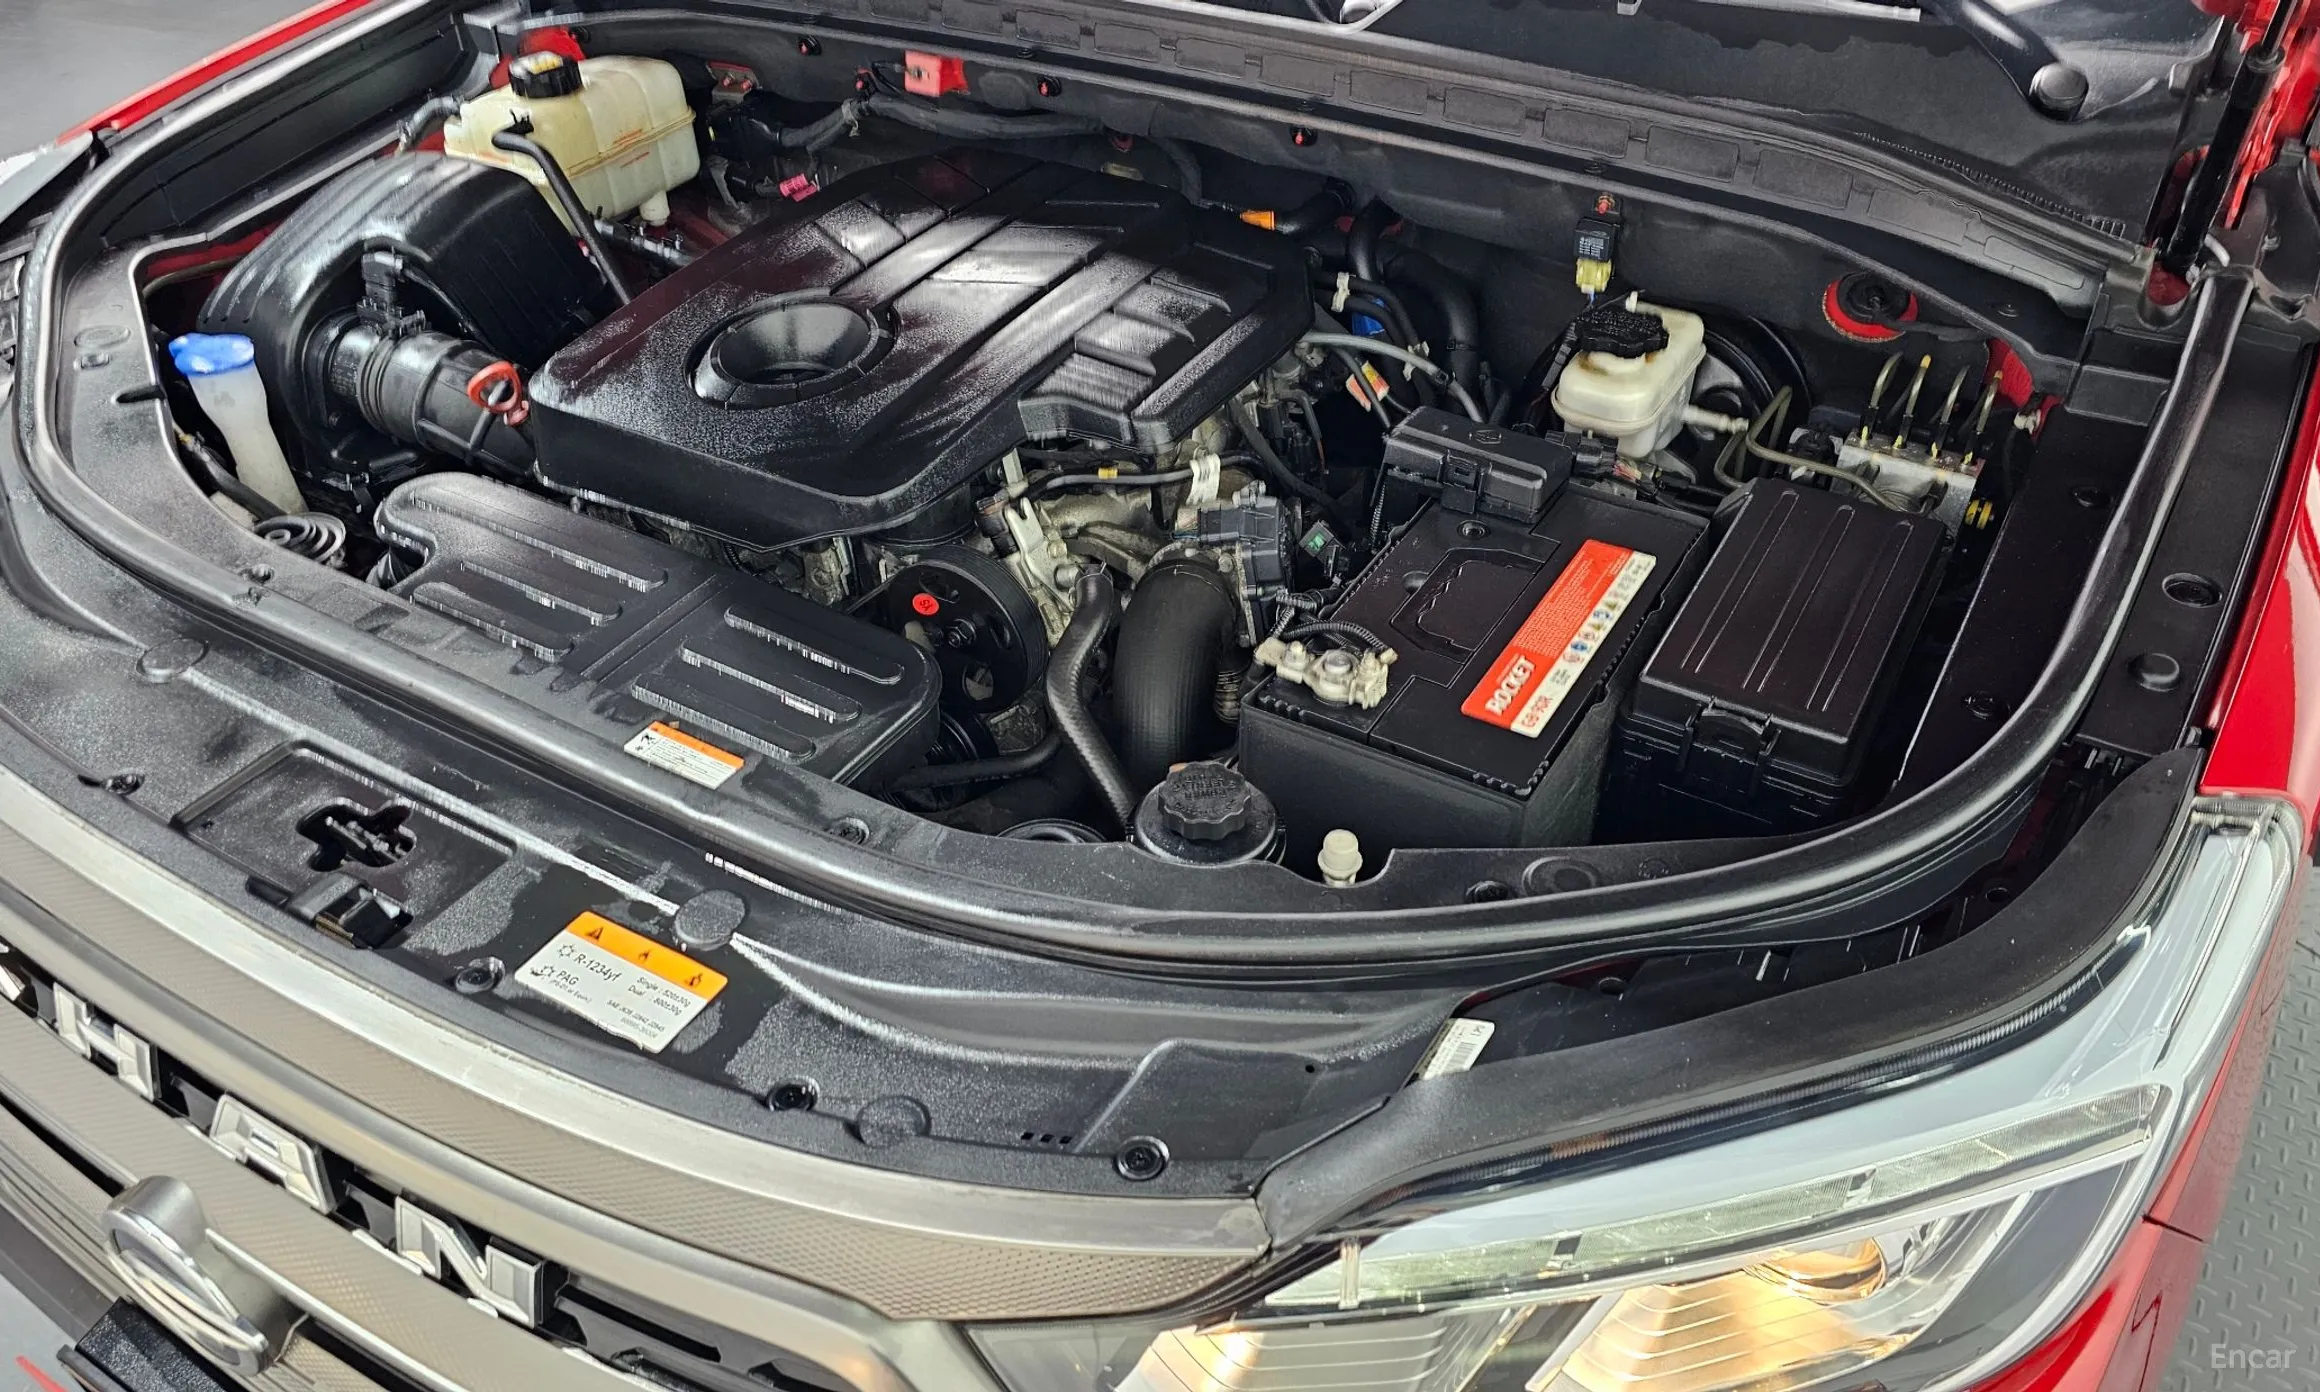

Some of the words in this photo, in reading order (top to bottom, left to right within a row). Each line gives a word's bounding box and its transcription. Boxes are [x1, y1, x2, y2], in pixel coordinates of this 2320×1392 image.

[1484, 655, 1537, 717] ROCKET
[556, 970, 579, 986] PAG
[574, 953, 623, 982] R-1234yf
